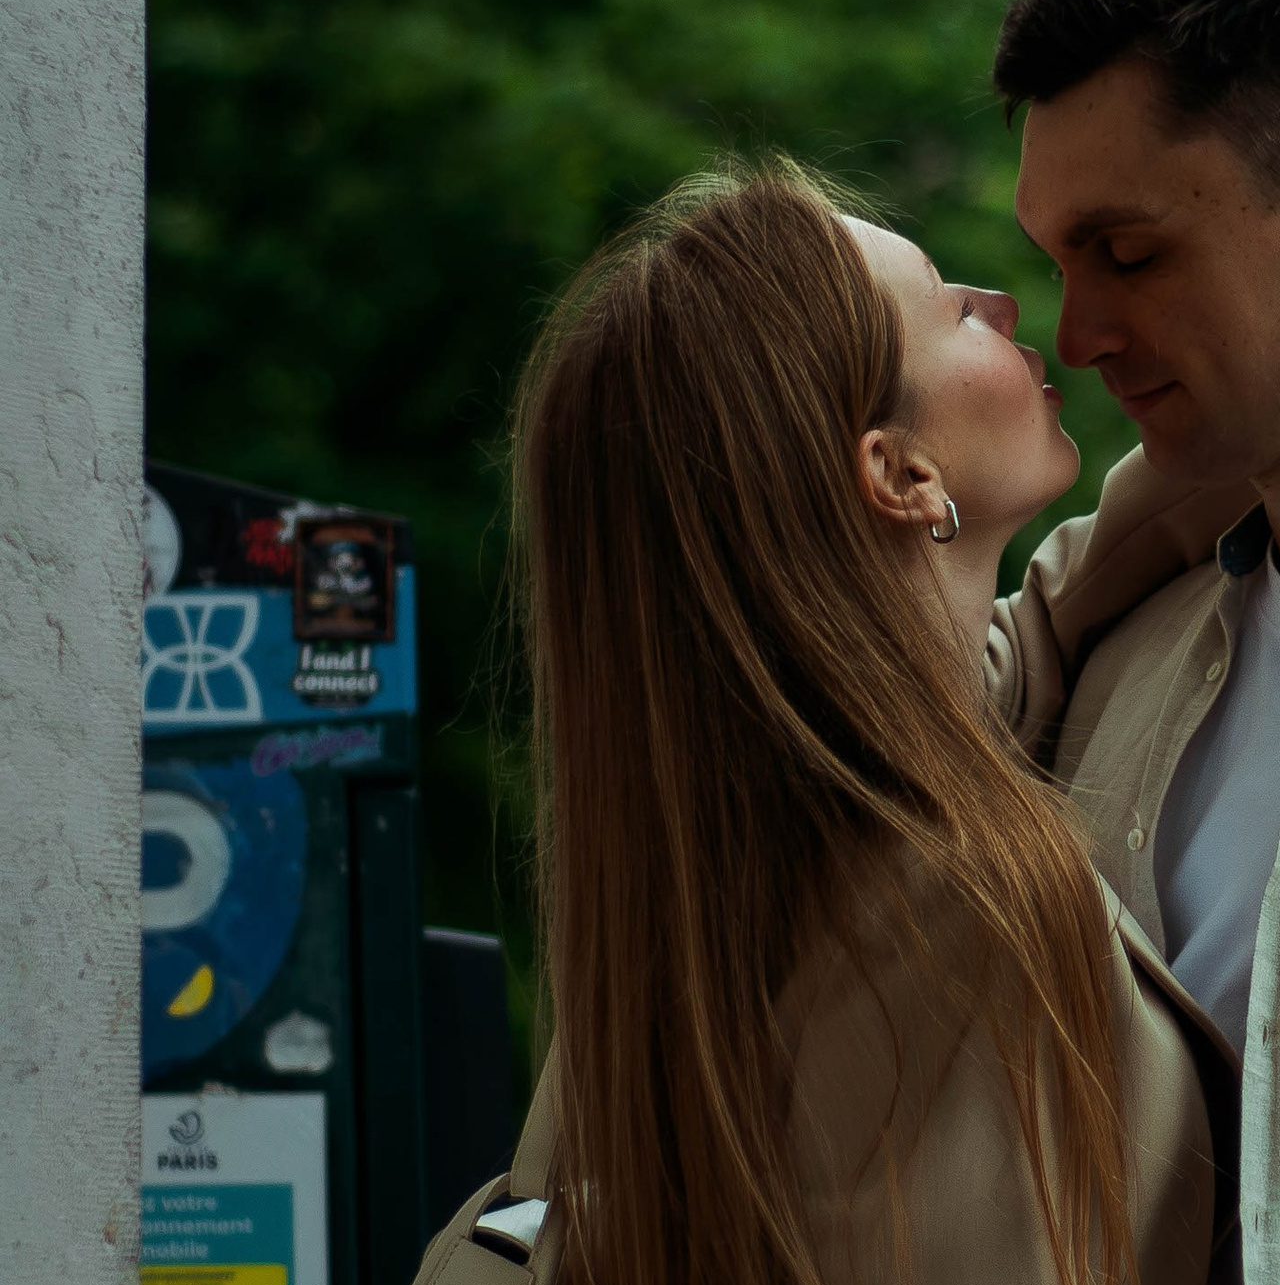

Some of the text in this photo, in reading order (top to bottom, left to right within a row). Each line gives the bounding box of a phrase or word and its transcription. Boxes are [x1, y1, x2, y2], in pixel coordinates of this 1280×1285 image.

[301, 644, 312, 670] I
[313, 651, 356, 670] and
[293, 674, 378, 694] connect
[157, 1154, 218, 1171] PARIS
[161, 1196, 218, 1212] votre
